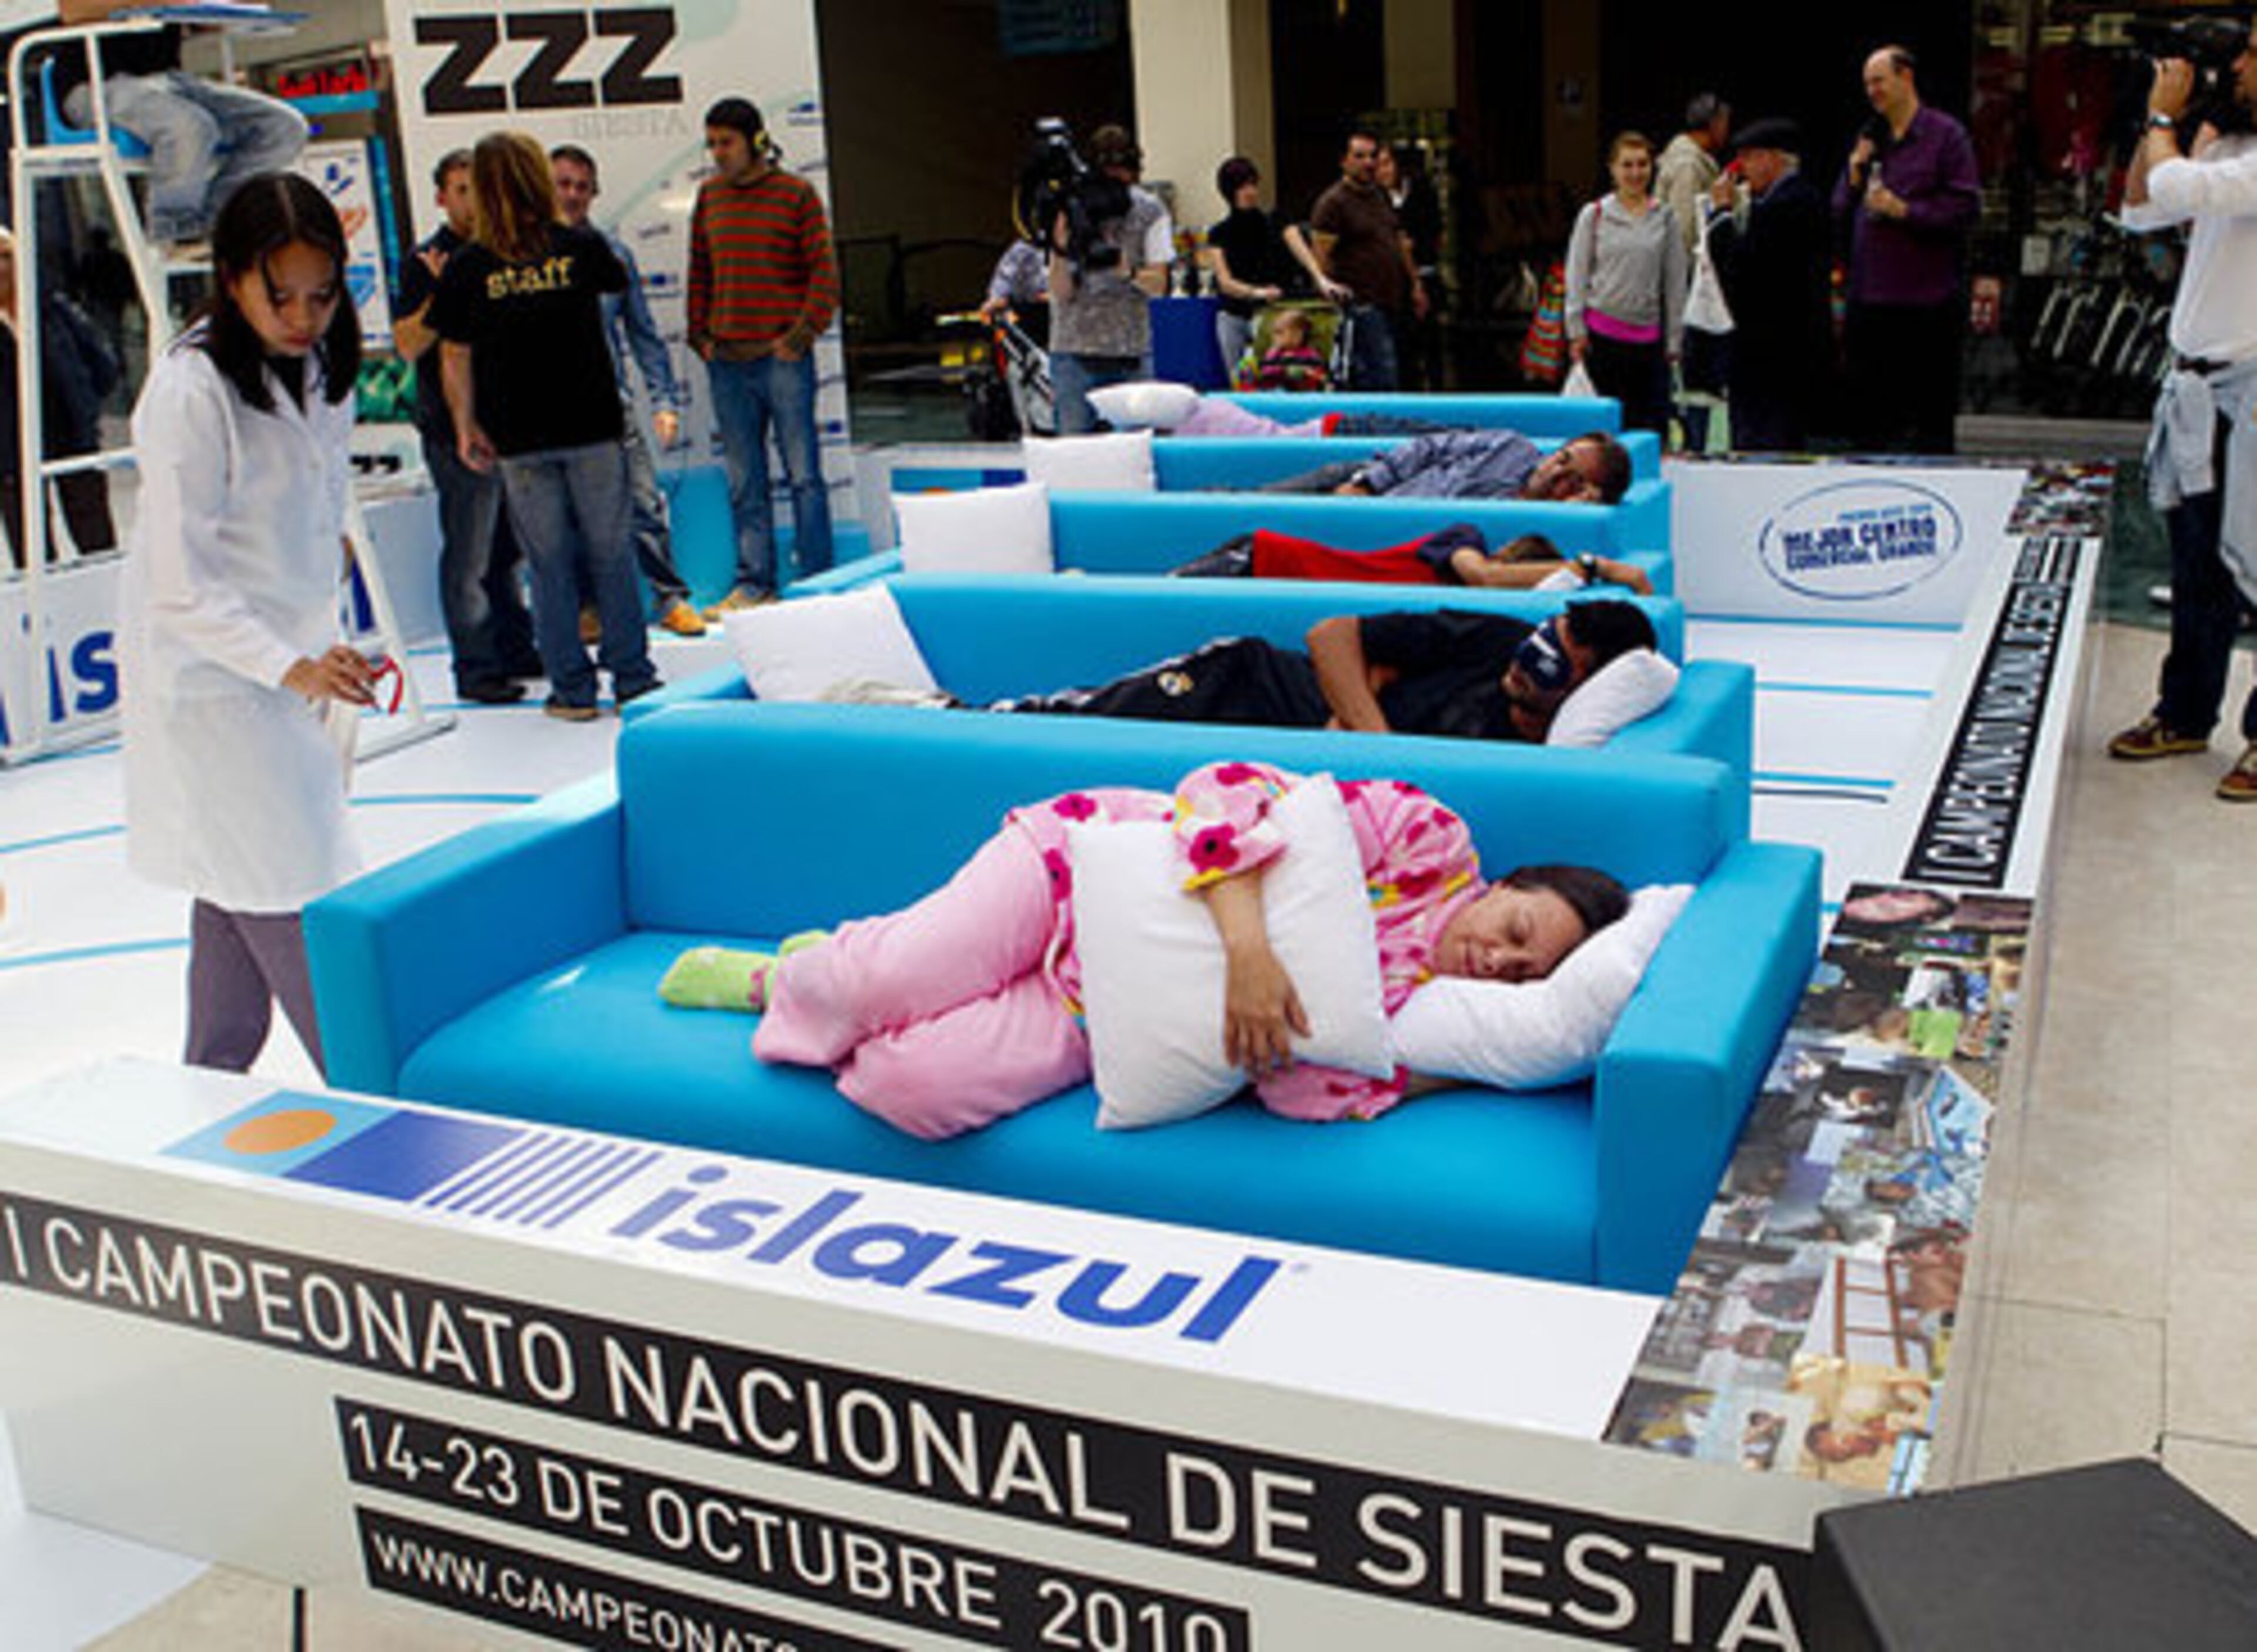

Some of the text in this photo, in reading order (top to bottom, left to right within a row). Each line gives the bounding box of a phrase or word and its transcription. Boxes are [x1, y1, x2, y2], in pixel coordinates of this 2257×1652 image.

[1926, 722, 2031, 866] CAMPEONATO
[610, 1164, 1283, 1343] islazul
[4, 1205, 1804, 1652] I CAMPEONATO NACIONAL DE SIESTA
[352, 1414, 1227, 1652] 14-23 DE OCTUBRE 2010
[373, 1533, 798, 1652] WWW.CAMPEONAT
